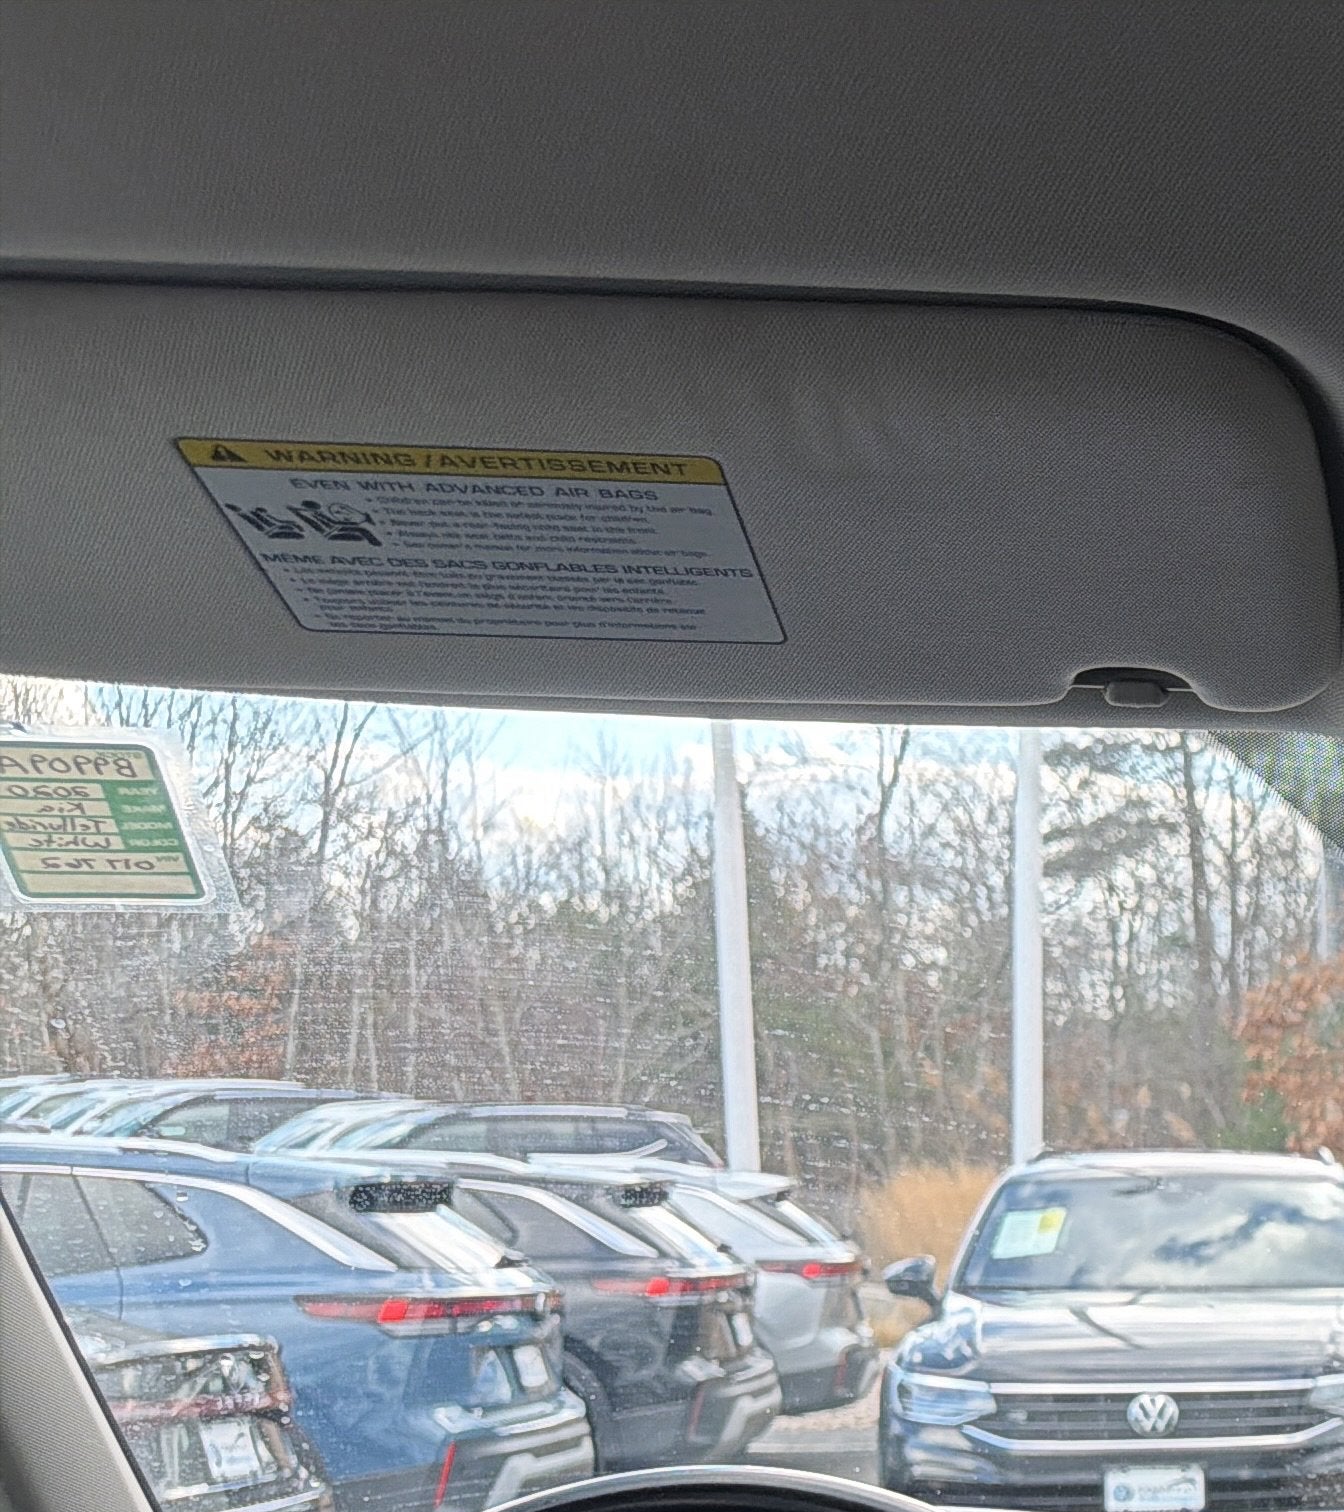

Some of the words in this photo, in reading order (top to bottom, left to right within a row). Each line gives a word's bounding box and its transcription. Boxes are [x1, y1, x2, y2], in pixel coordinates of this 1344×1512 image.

[264, 449, 416, 467] WARNING
[440, 454, 688, 477] AVERTISSEMENT
[290, 478, 350, 491] EVEN
[356, 480, 414, 492] WITH
[425, 482, 544, 497] ADVANCED
[555, 486, 590, 499] AIR
[599, 488, 659, 501] BAGS
[330, 554, 384, 567] AVEC
[387, 557, 429, 569] DES
[432, 558, 488, 571] SACS
[492, 560, 618, 575] GONFLABLES
[623, 564, 753, 578] INTELLIGENTS
